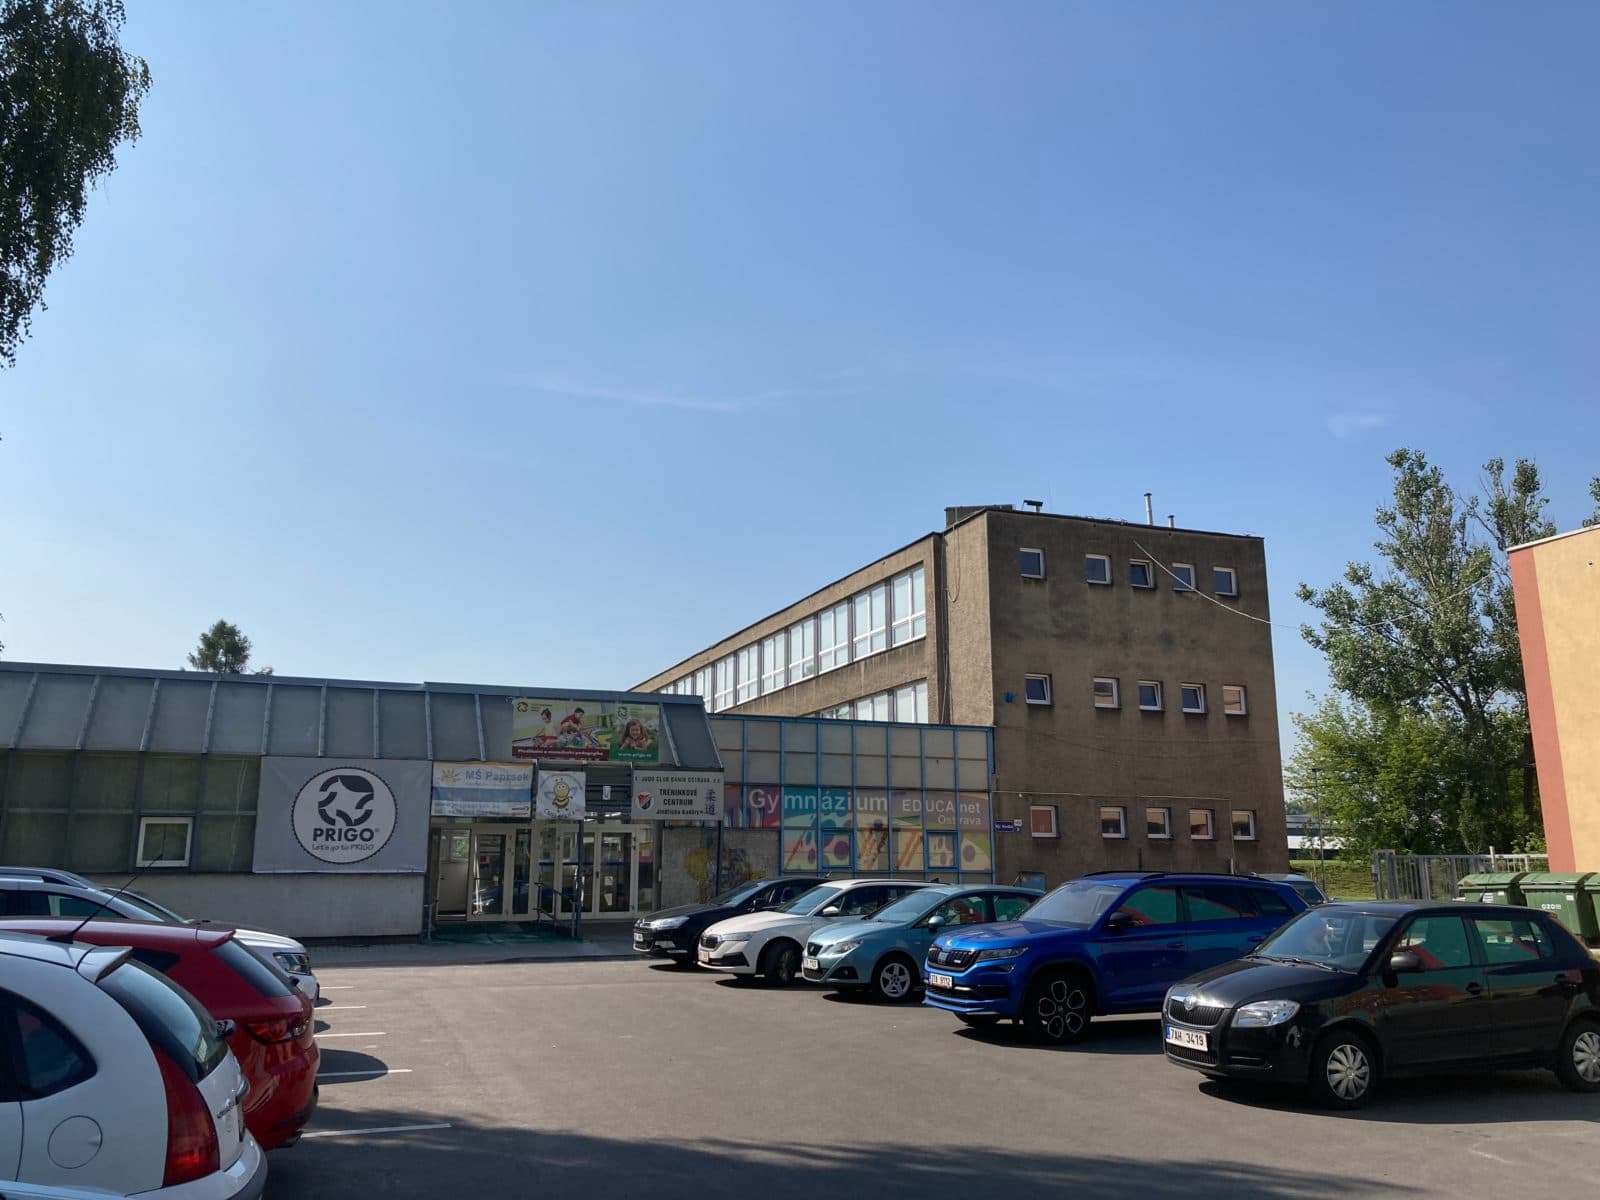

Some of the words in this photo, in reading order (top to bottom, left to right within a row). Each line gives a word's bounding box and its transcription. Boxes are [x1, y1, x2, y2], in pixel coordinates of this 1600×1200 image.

[485, 770, 529, 784] Paprsek
[663, 798, 694, 806] CENTRUM
[749, 788, 888, 814] Gymnázium
[937, 815, 982, 825] Ostrava
[313, 827, 375, 842] PRIGO
[331, 844, 340, 852] go
[350, 843, 375, 851] PRIGO
[1185, 1032, 1205, 1046] 3419
